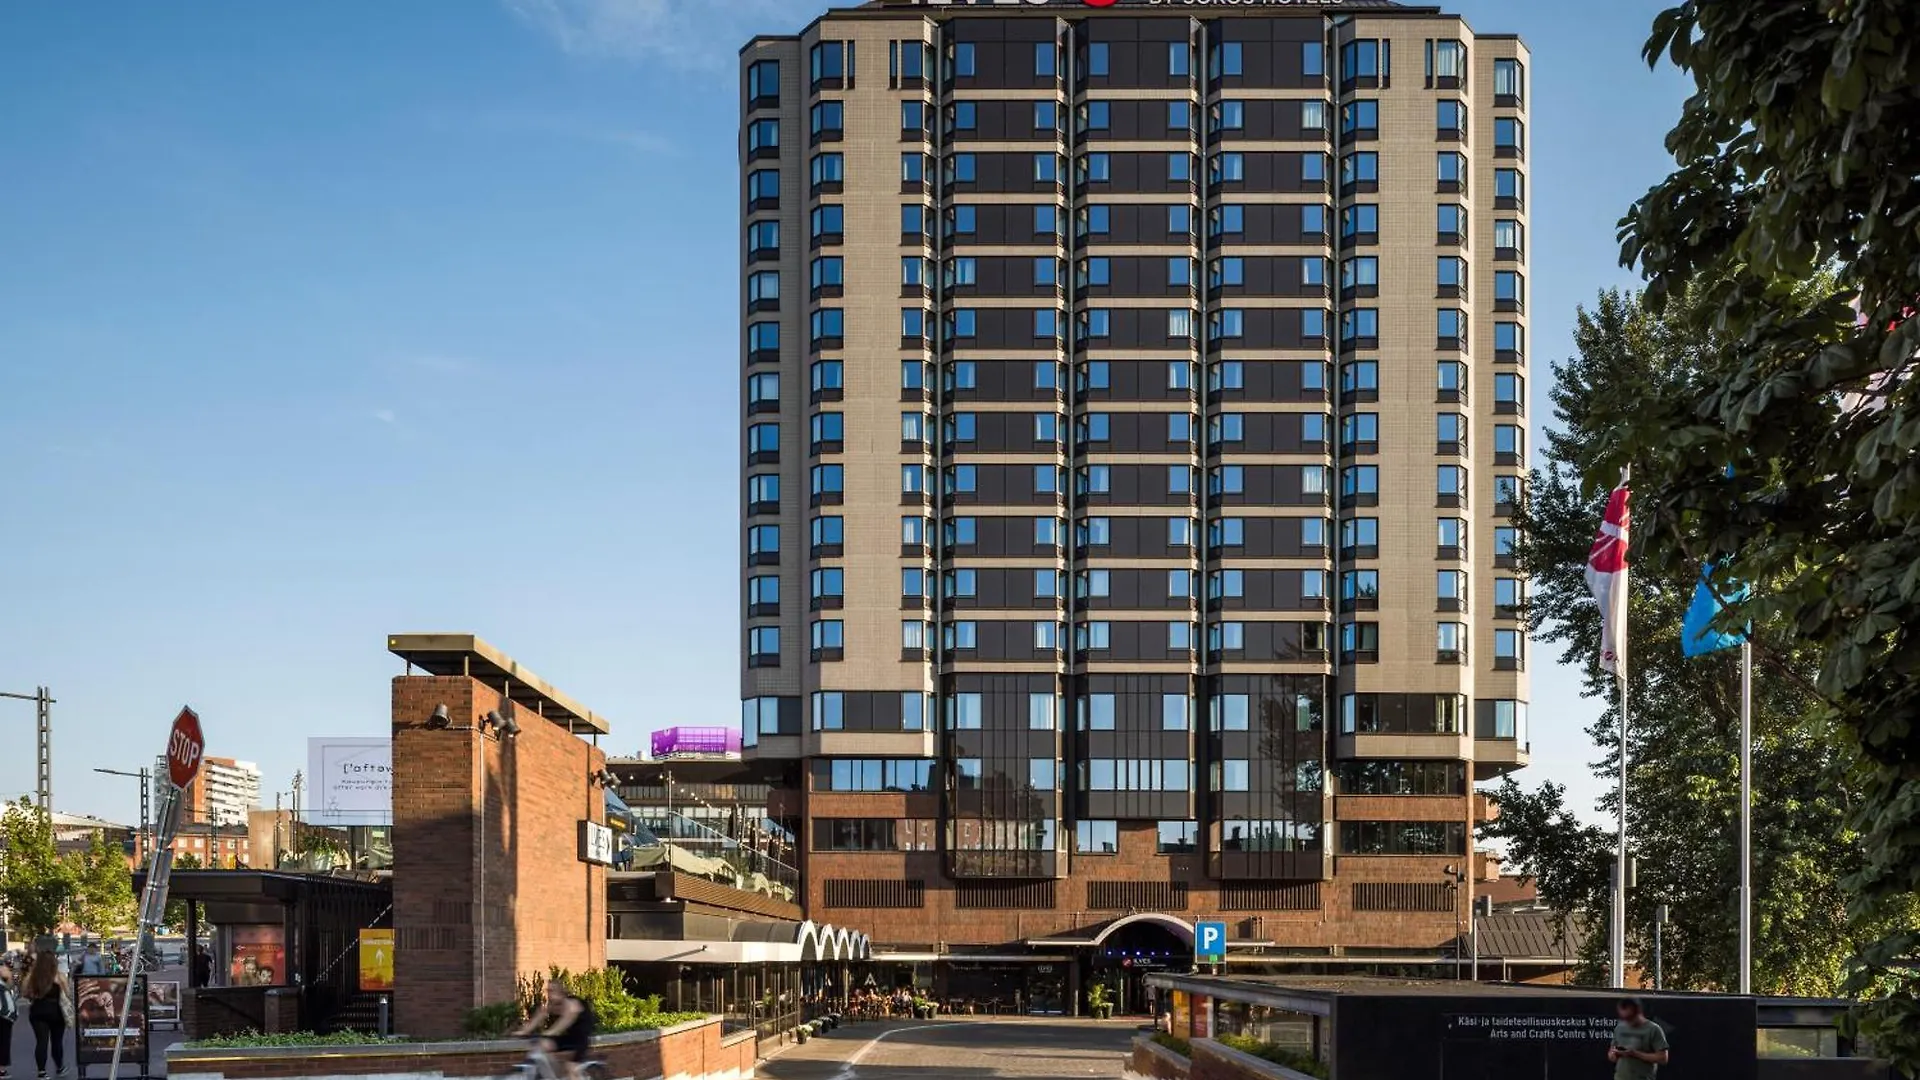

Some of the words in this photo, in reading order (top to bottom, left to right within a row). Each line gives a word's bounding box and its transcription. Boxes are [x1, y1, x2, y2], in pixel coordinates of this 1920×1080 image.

[170, 729, 199, 769] STOP
[1204, 926, 1218, 950] P
[1491, 1016, 1586, 1026] taideteollisuuskeskus
[1589, 1017, 1617, 1026] Verkar
[1490, 1029, 1508, 1039] Arts
[1511, 1029, 1527, 1039] and
[1529, 1029, 1555, 1039] Crafts
[1557, 1029, 1586, 1039] Centre
[1589, 1029, 1614, 1039] Verka
